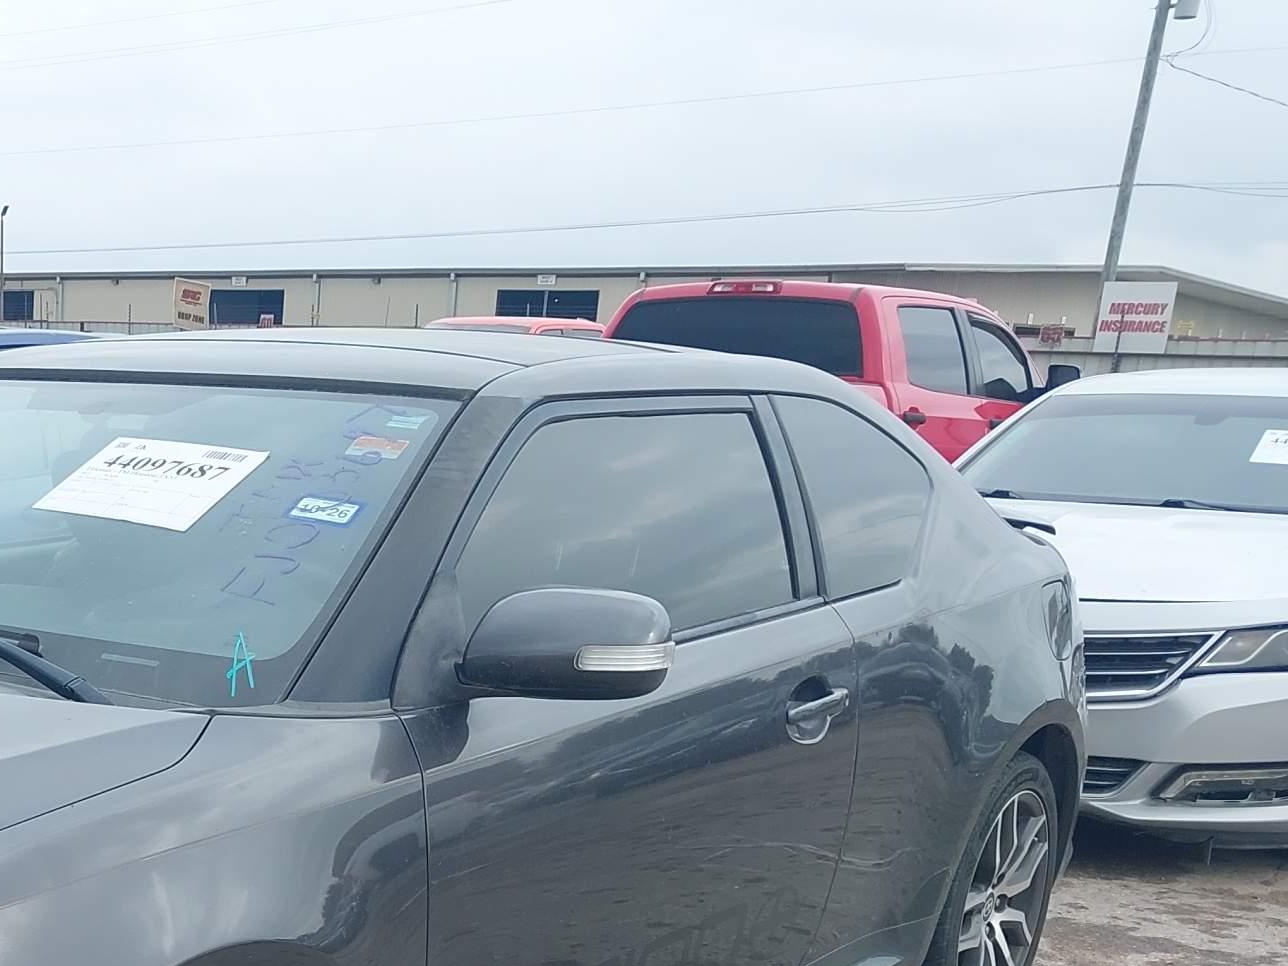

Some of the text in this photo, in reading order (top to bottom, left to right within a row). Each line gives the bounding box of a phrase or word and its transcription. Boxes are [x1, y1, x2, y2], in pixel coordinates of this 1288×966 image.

[1108, 302, 1169, 315] MERCURY
[1098, 319, 1168, 333] INSURANCE
[103, 454, 232, 481] 44097687
[226, 631, 257, 697] A
